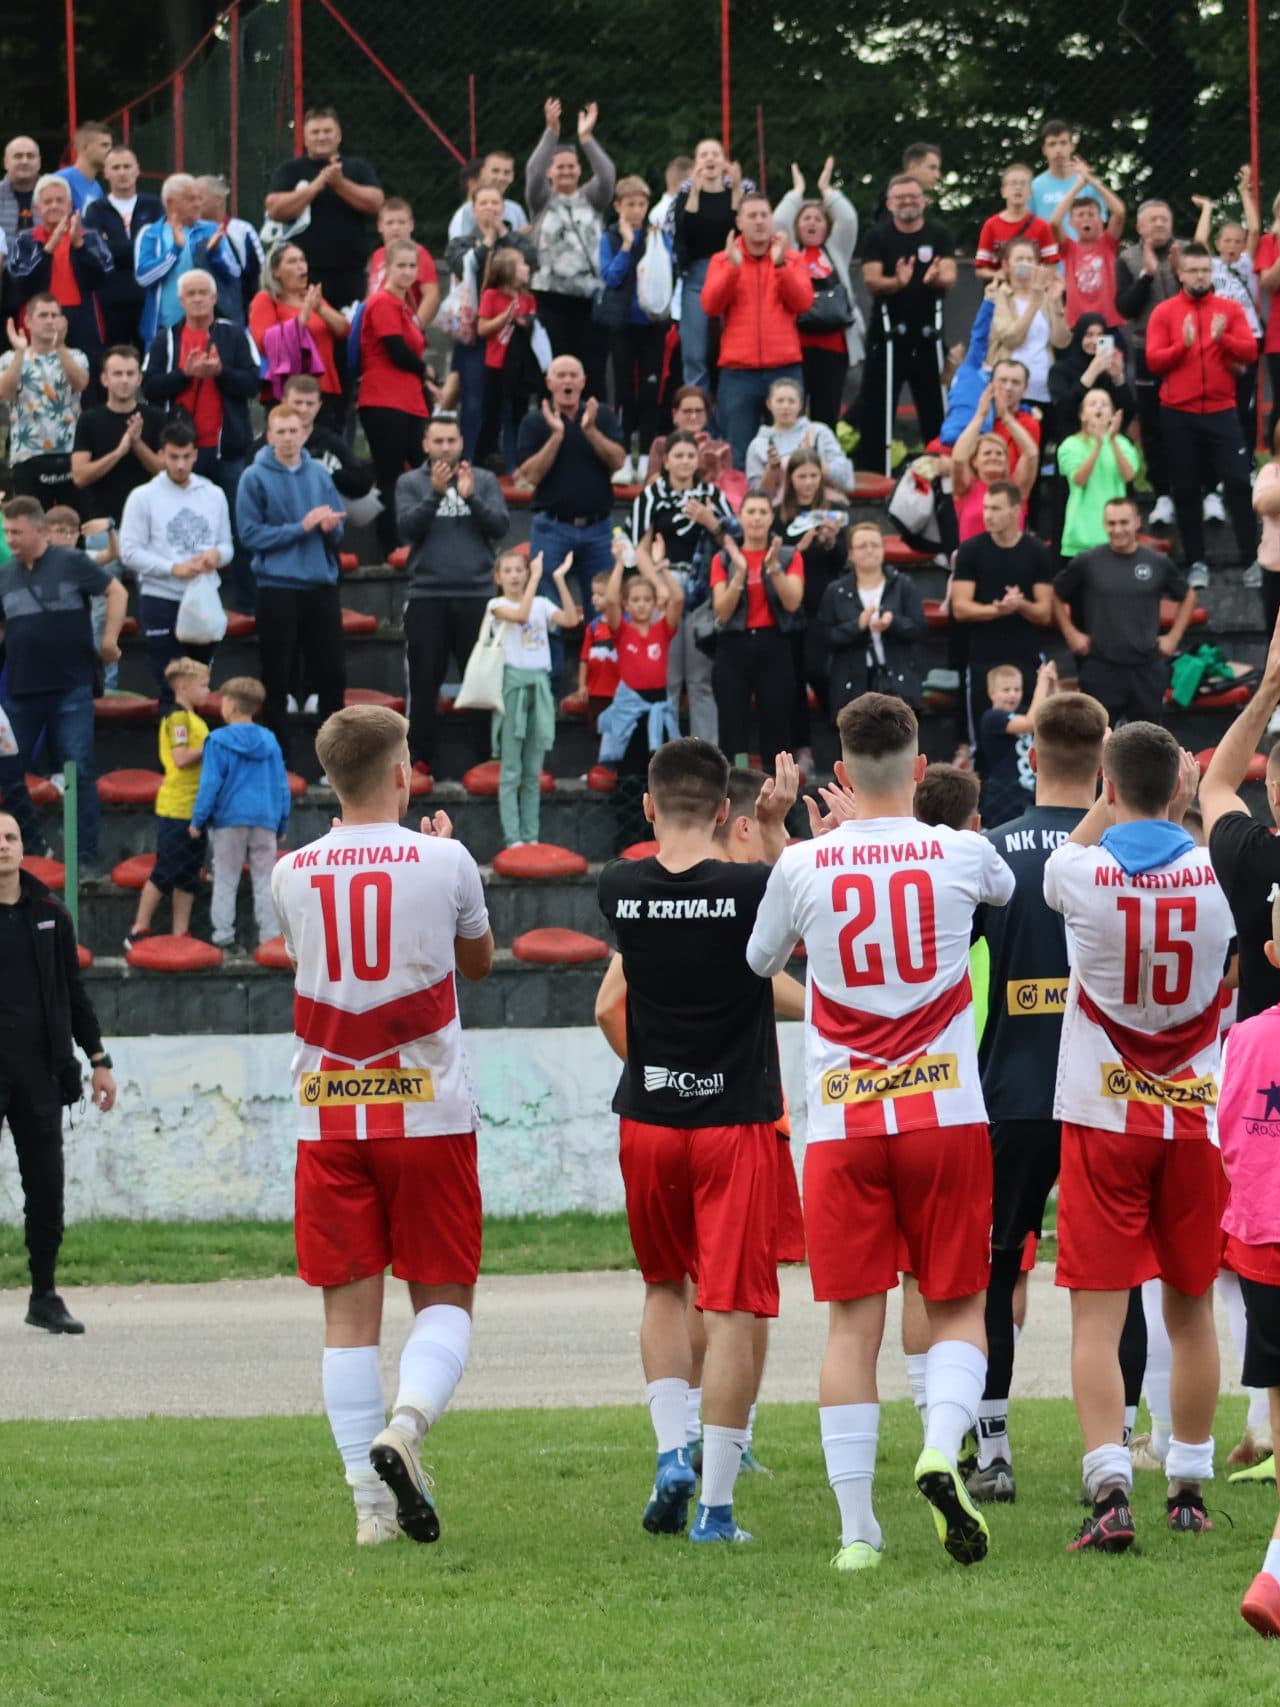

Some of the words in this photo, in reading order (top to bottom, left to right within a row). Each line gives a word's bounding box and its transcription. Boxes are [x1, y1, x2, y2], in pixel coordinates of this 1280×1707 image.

[1005, 829, 1036, 853] NK
[293, 850, 321, 870] NK
[326, 846, 420, 866] KRIVAJA
[815, 846, 845, 869] NK
[852, 840, 945, 865] KRIVAJA
[1095, 866, 1124, 886] NK
[1131, 865, 1216, 888] KRIVAJA
[616, 899, 642, 919] NK
[647, 898, 737, 919] KRIVAJA
[310, 871, 392, 982] 10
[831, 869, 938, 988] 20
[1116, 896, 1197, 1006] 15
[327, 1078, 423, 1097] MOZZART
[855, 1063, 950, 1095] MOZZART
